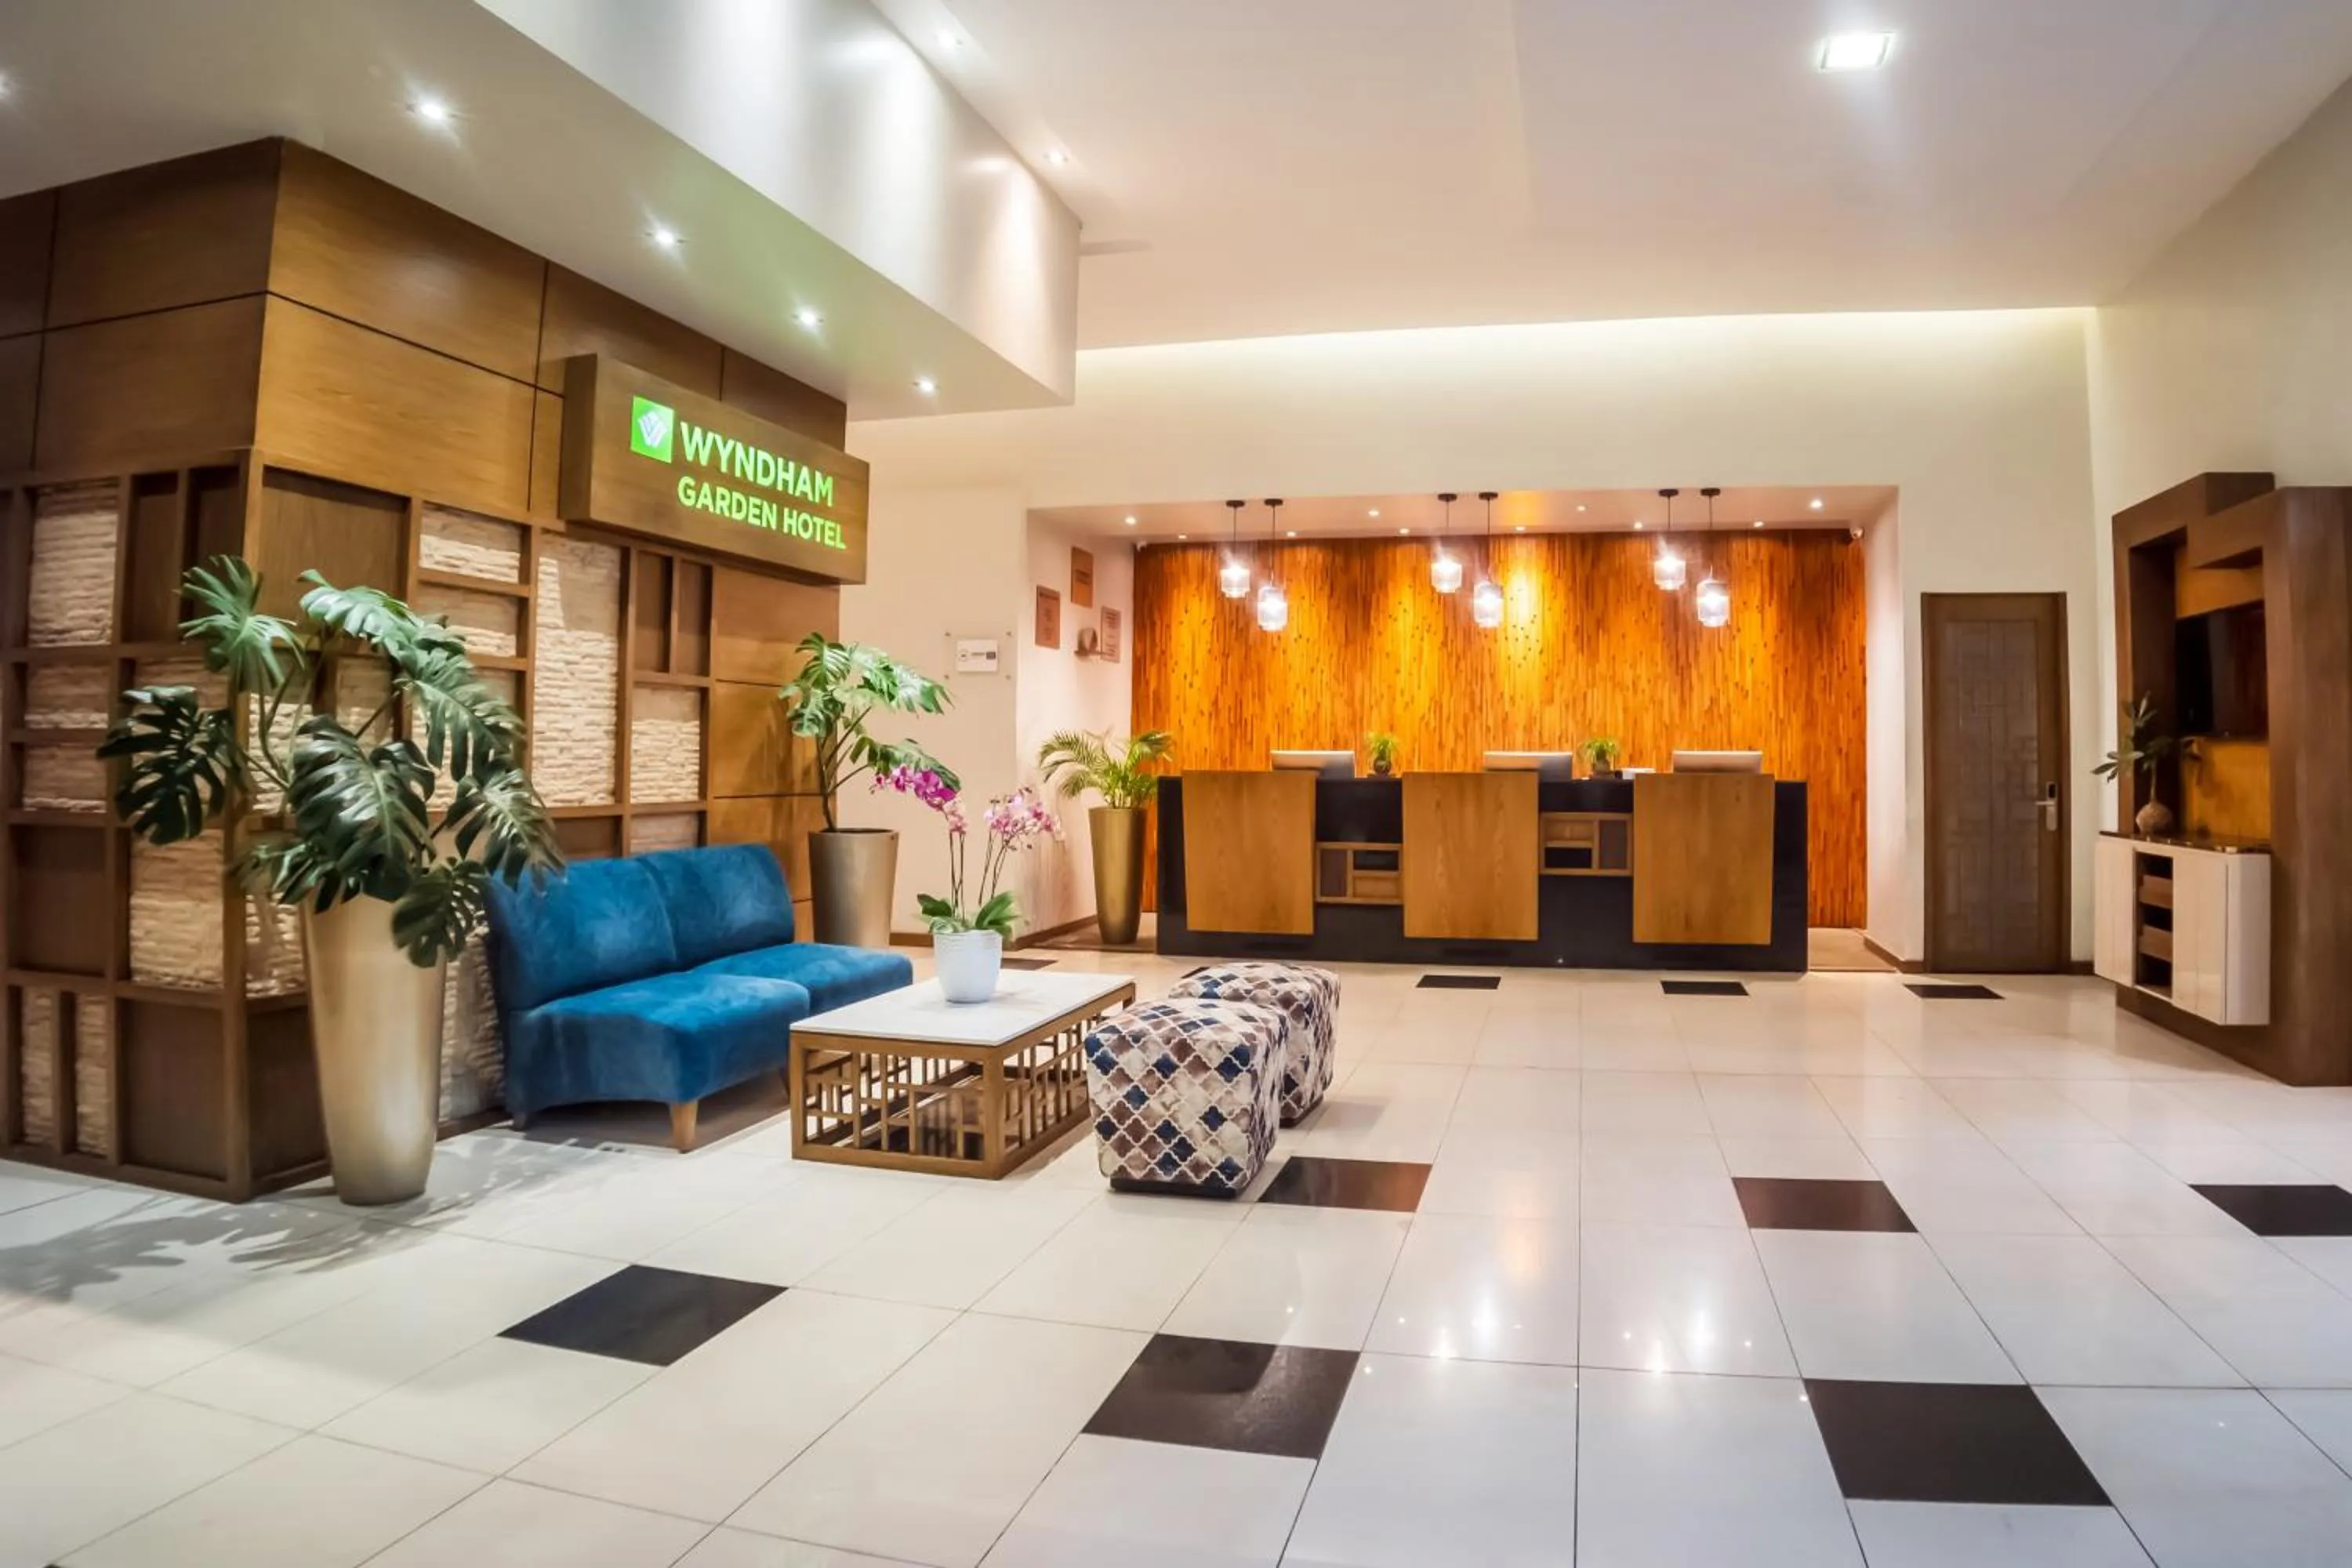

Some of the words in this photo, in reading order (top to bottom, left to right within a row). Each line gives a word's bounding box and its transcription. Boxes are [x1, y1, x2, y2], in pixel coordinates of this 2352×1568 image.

[680, 421, 833, 507] WYNDHAM
[677, 476, 778, 531] GARDEN
[782, 507, 847, 550] HOTEL
